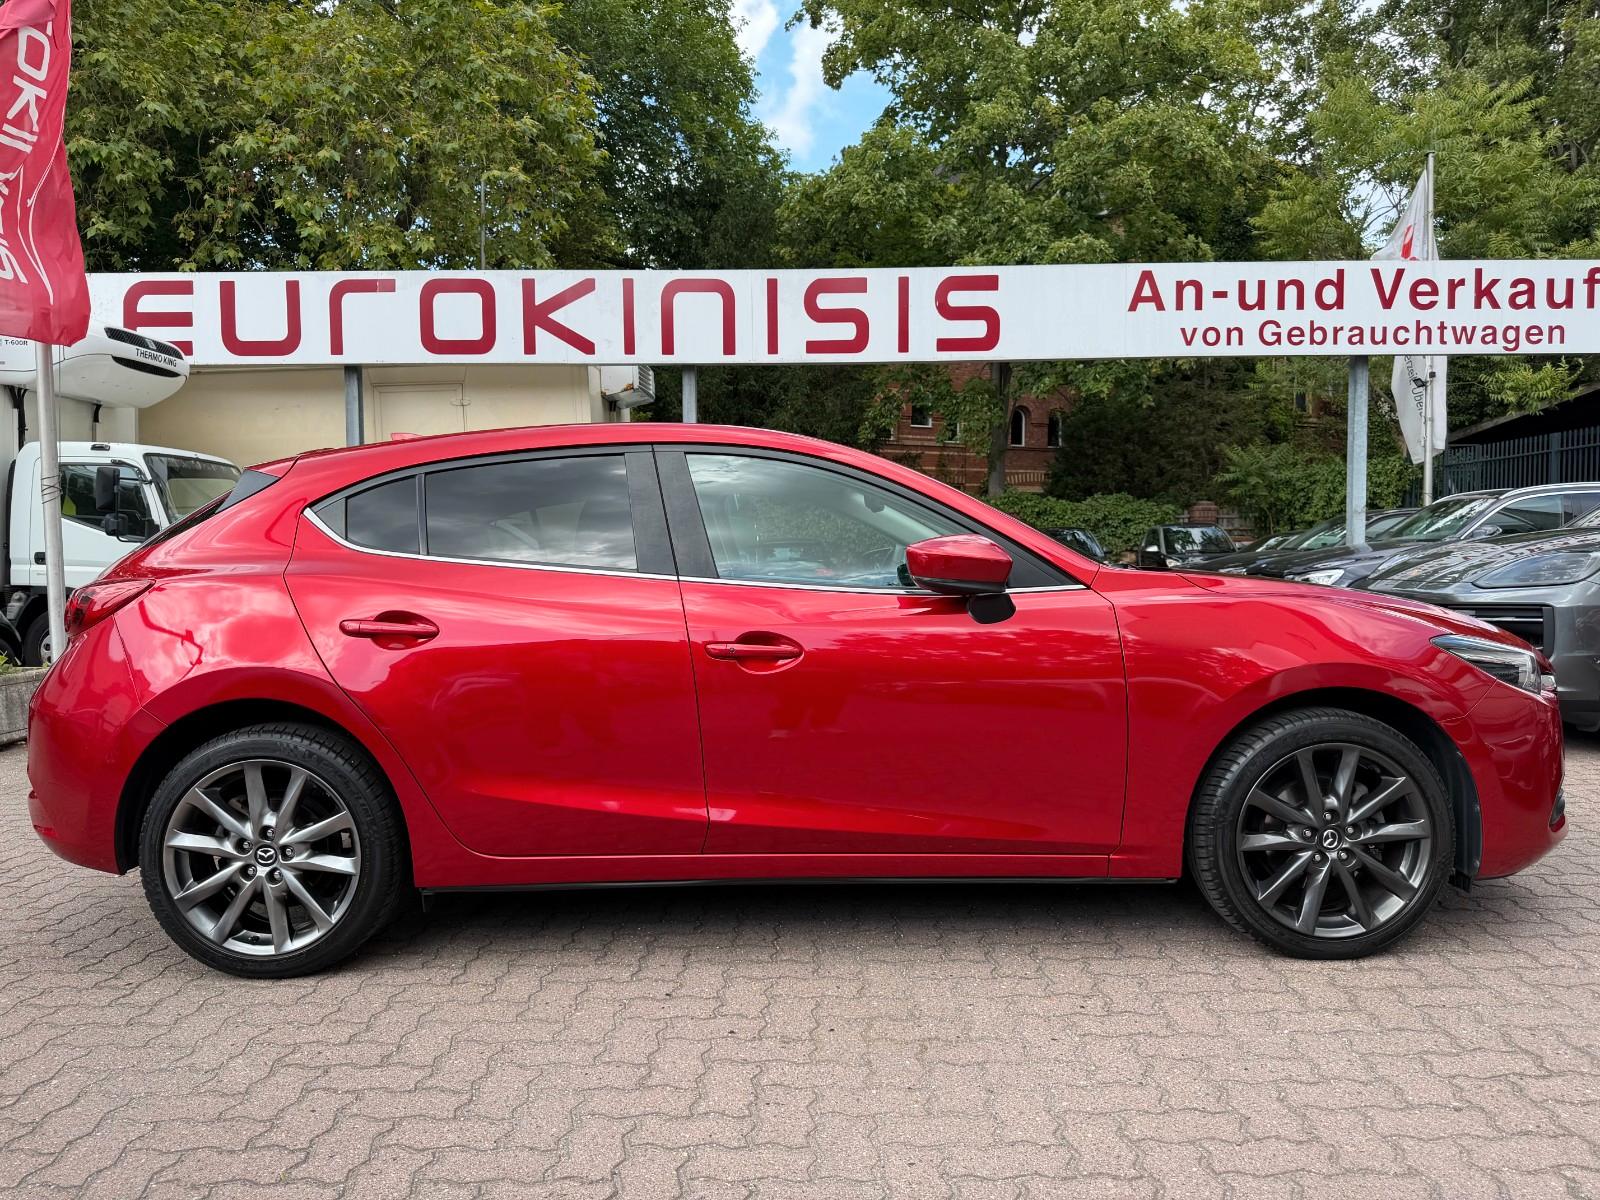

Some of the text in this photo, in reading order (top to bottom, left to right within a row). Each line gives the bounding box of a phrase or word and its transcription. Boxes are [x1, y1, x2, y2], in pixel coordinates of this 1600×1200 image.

[1370, 266, 1600, 310] Verkauf
[123, 275, 1000, 356] EUROKINISIS
[1180, 319, 1566, 352] von Gebrauchtwagen
[135, 348, 177, 367] THERMO KING
